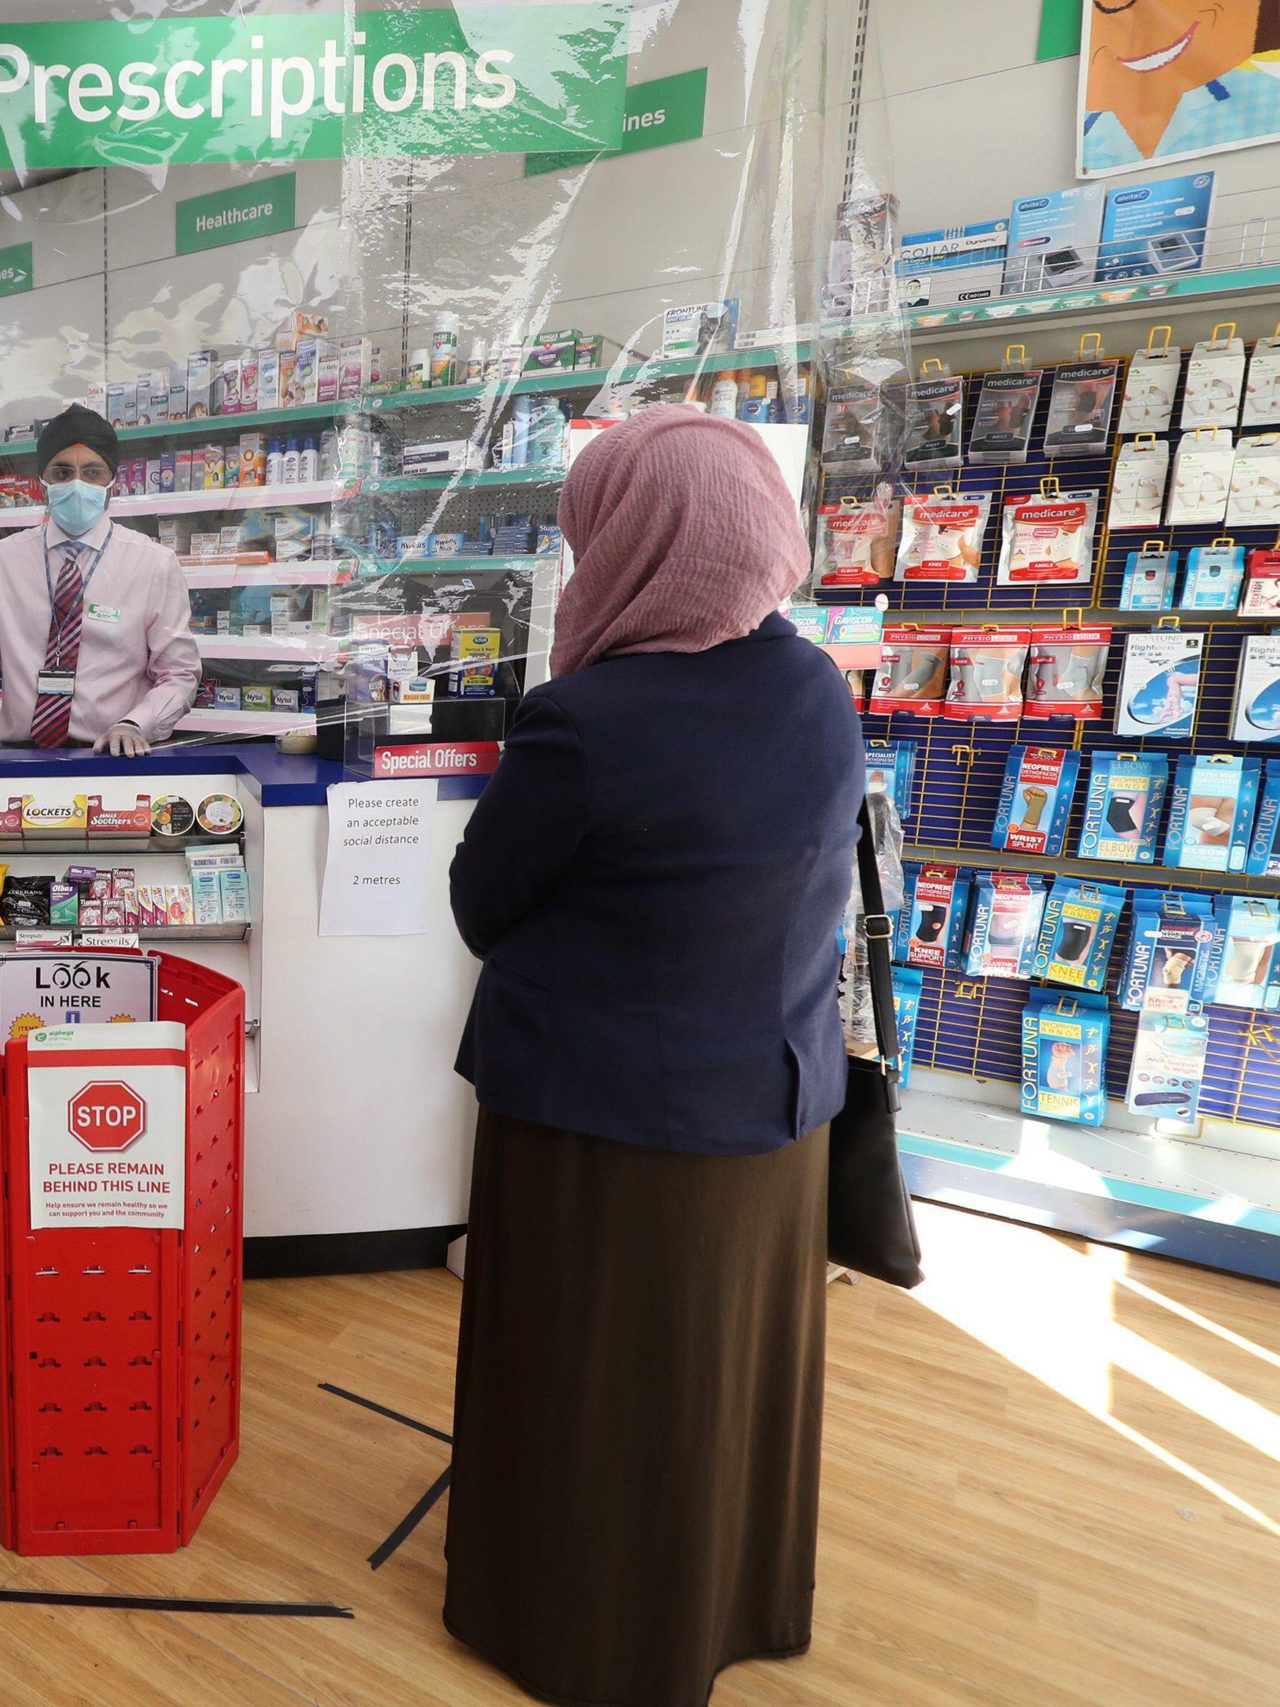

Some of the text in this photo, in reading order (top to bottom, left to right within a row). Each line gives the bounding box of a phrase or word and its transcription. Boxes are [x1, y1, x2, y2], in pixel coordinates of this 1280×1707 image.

[195, 201, 274, 233] Healthcare
[1061, 367, 1108, 380] medicare
[987, 377, 1032, 389] medicare
[911, 386, 955, 398] medicare
[920, 510, 966, 519] medicare
[1021, 509, 1072, 520] medicare
[834, 615, 873, 625] GAVISCON
[219, 693, 234, 701] Nytol
[246, 693, 263, 702] Nytol
[276, 696, 292, 705] Nytol
[381, 749, 477, 774] Special Offers
[1022, 762, 1061, 773] NEOPRENE
[348, 798, 419, 808] Please create
[995, 775, 1017, 834] FORTUNA
[26, 807, 72, 818] LOCKETS
[1081, 773, 1110, 857] FORTUNA
[90, 815, 131, 826] Soothers
[347, 815, 419, 829] an acceptable
[1167, 787, 1189, 851] FORTUNA
[1251, 799, 1279, 861] FORTUNA
[343, 834, 419, 846] social distance
[1009, 833, 1044, 844] WRIST
[1011, 840, 1040, 849] SPLINT
[1099, 841, 1137, 853] ELBOW
[353, 876, 401, 885] 2 metres
[918, 882, 953, 891] NEOPRENE
[52, 884, 73, 892] Olbas
[971, 906, 990, 963] FORTUNA
[1032, 900, 1062, 977] FORTUNA
[910, 952, 944, 962] SUPPORT
[914, 947, 941, 956] KNEE
[36, 963, 111, 989] Look
[1050, 964, 1084, 978] KNEE
[1128, 945, 1151, 1007] FORTUNA
[40, 996, 101, 1008] IN HERE
[1022, 1016, 1039, 1110] FORTUNA
[77, 1105, 137, 1127] STOP
[49, 1163, 164, 1175] PLEASE REMAIN
[43, 1180, 170, 1193] BEHIND THIS LINE
[46, 1202, 61, 1210] Help
[123, 1201, 148, 1210] healthy
[62, 1210, 88, 1218] support
[127, 1210, 165, 1218] community
